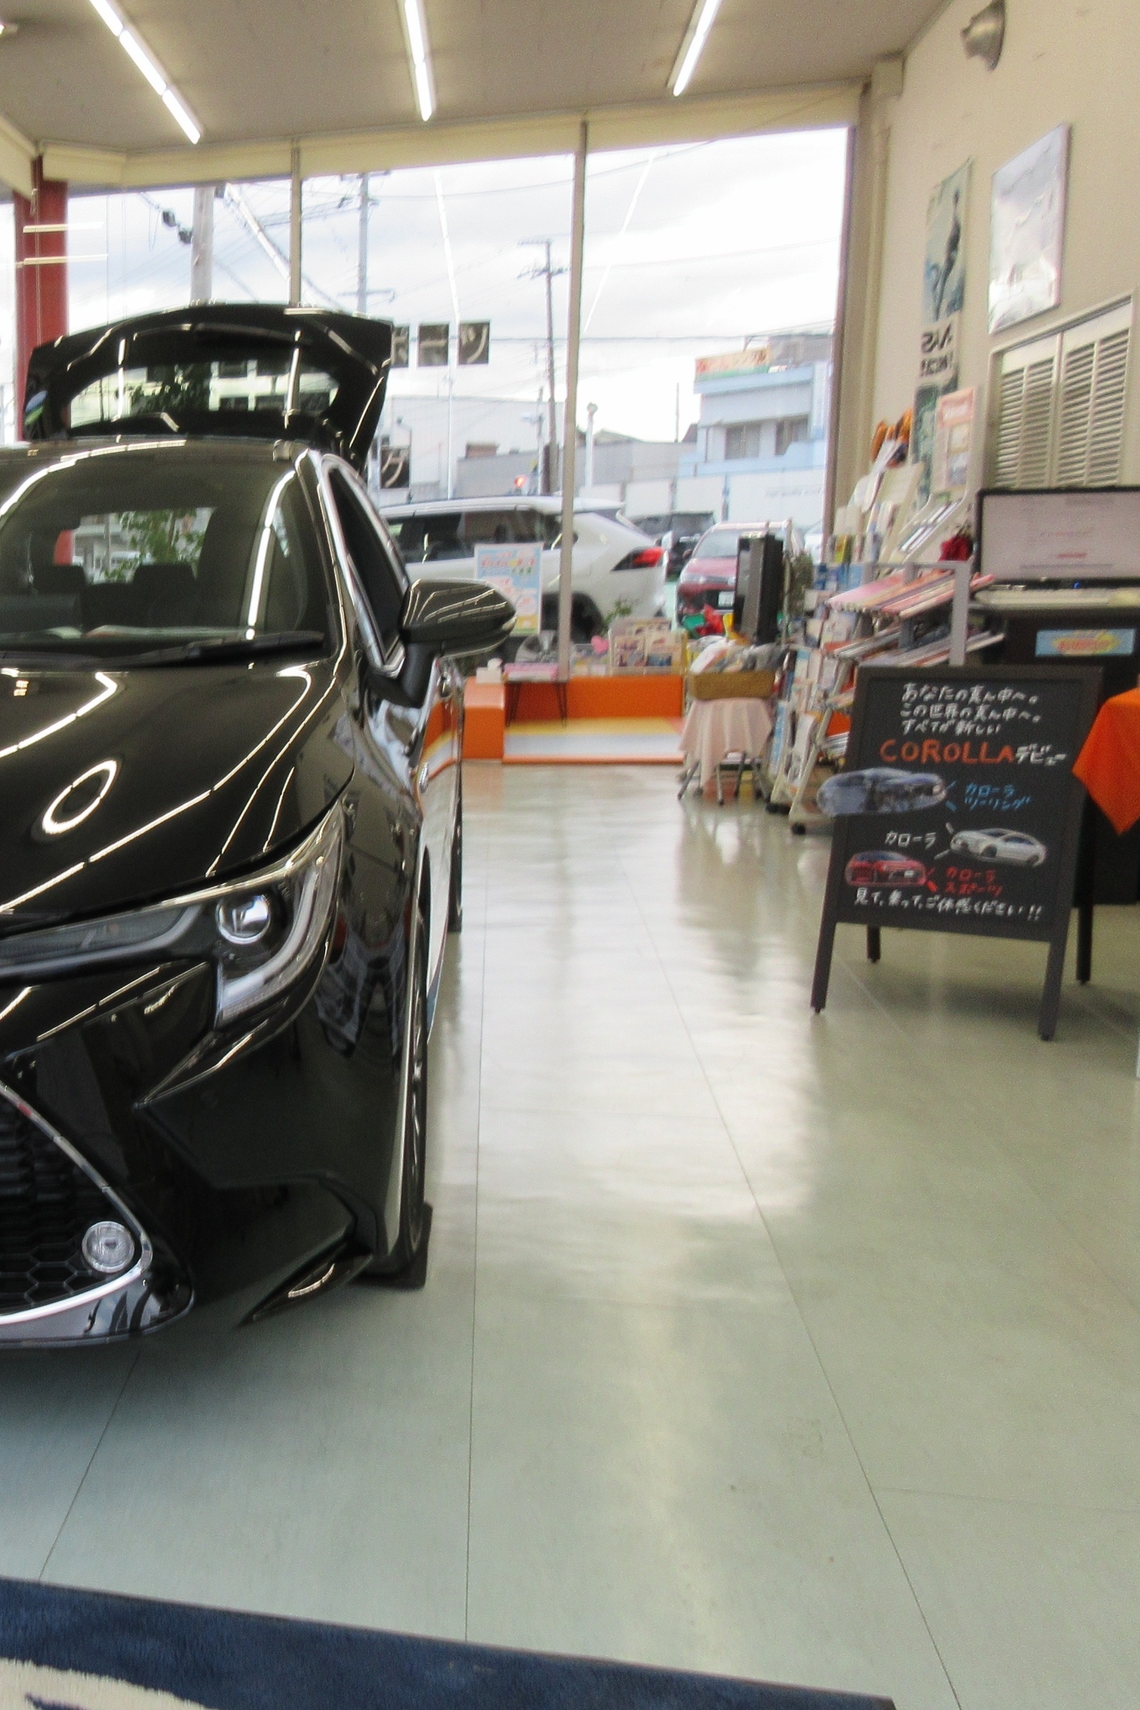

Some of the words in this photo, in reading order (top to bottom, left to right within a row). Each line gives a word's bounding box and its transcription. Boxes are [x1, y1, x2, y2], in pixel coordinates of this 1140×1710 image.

[901, 682, 1039, 706] あなたの真ん中へ。
[900, 702, 1042, 724] この世界の真ん中へ。
[901, 718, 1002, 736] すべてが新しい
[880, 738, 1015, 765] COROLLA
[965, 781, 1017, 798] カローラ
[964, 796, 1032, 812] ツーリング
[884, 830, 937, 850] カローラ
[945, 866, 997, 884] カローラ
